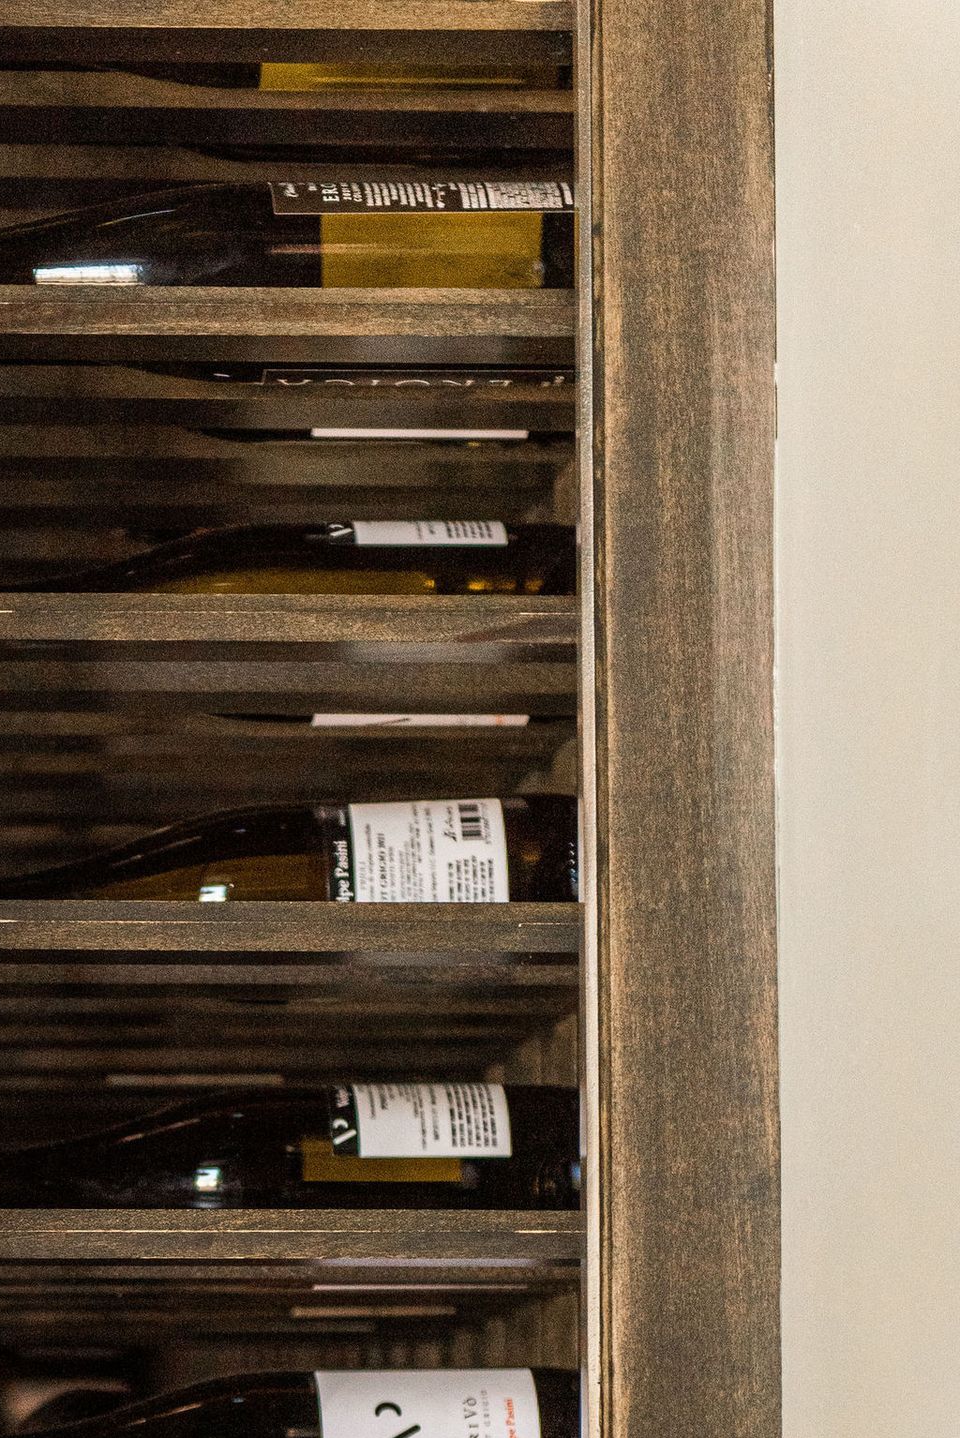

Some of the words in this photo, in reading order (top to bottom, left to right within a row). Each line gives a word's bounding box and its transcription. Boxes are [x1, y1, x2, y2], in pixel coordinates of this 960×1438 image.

[332, 840, 350, 878] Pasini
[334, 880, 354, 902] lpe
[504, 1396, 516, 1426] Pasini
